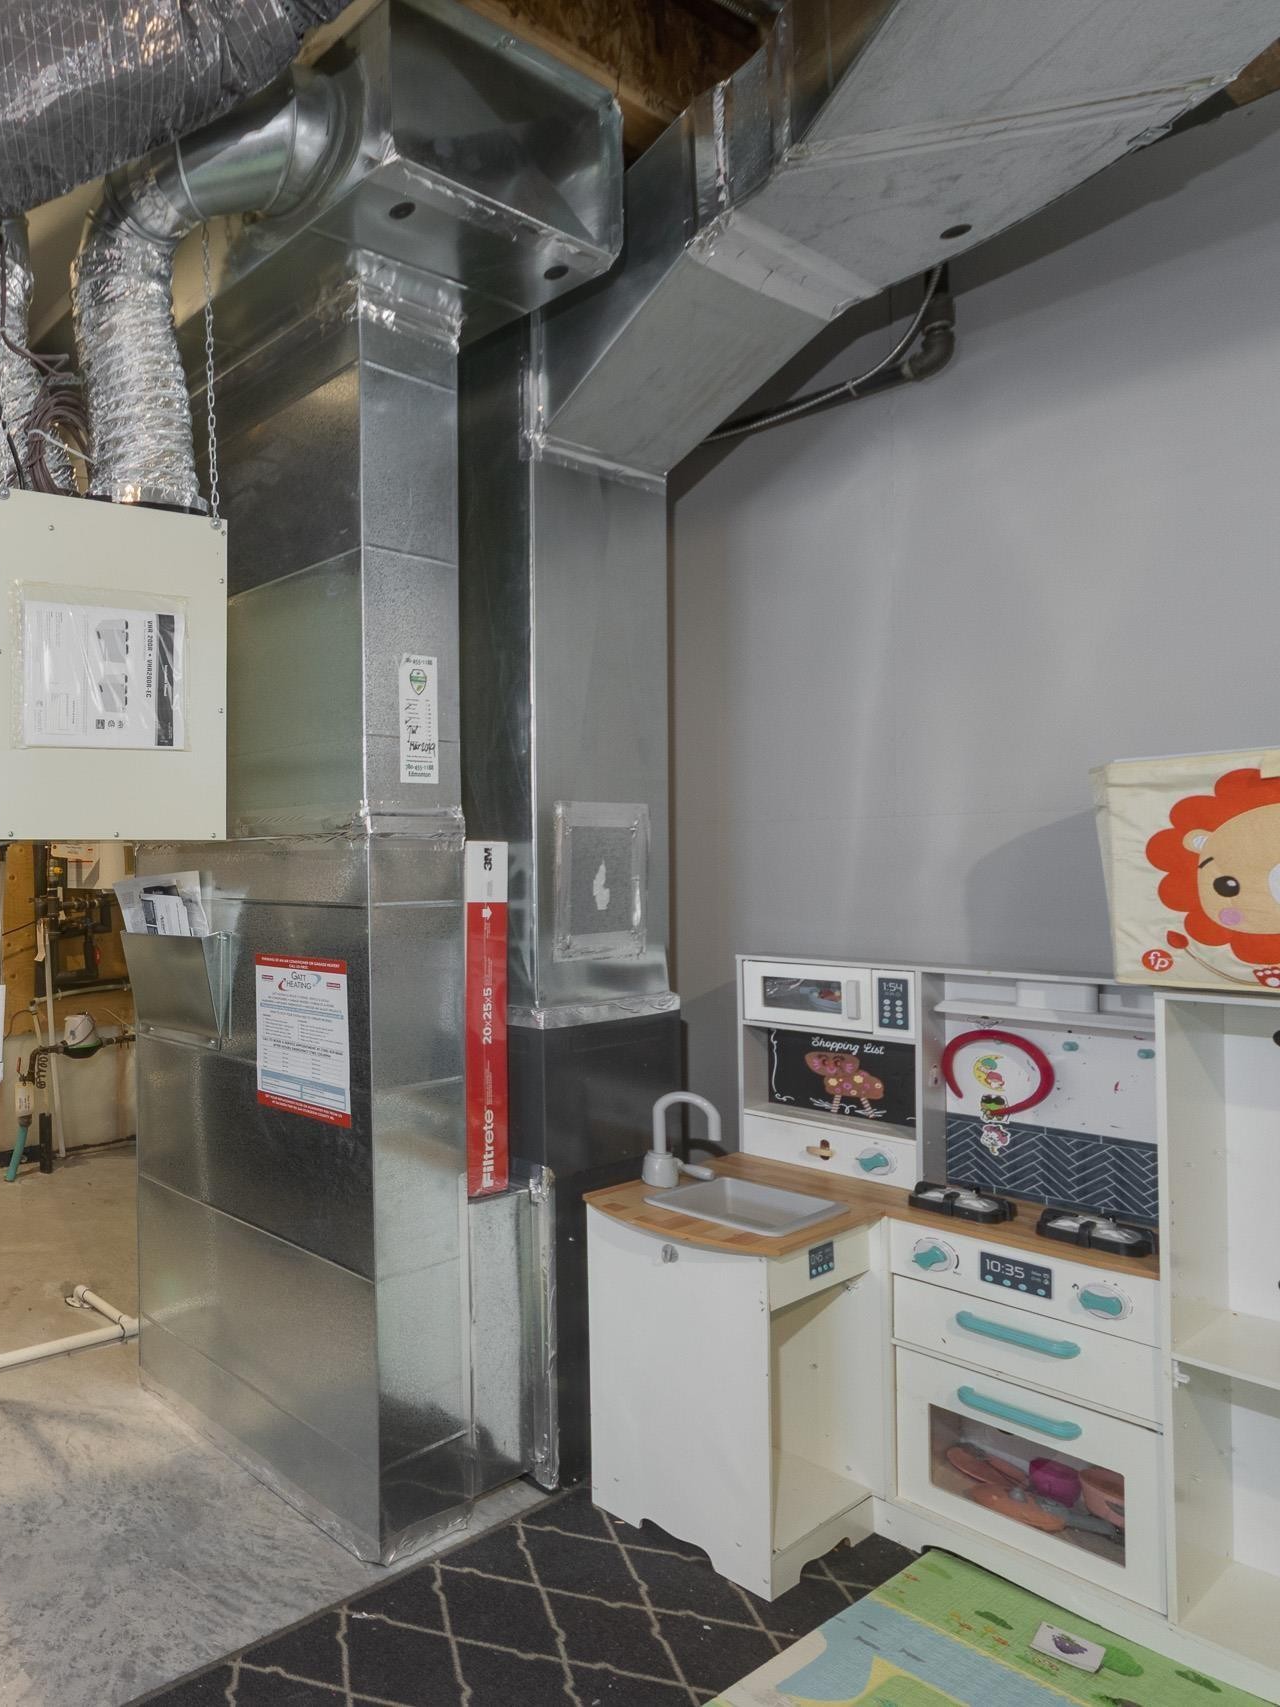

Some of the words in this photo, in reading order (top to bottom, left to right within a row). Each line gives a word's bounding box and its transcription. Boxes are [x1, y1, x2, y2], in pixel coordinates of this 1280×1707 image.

[484, 847, 493, 871] 3M
[1148, 950, 1170, 970] fp
[286, 981, 311, 990] HEATING
[882, 982, 903, 992] 1:54
[811, 1036, 860, 1056] Shopping
[863, 1042, 886, 1055] List
[482, 1110, 495, 1188] Filtrete
[985, 1258, 1025, 1279] 10:35
